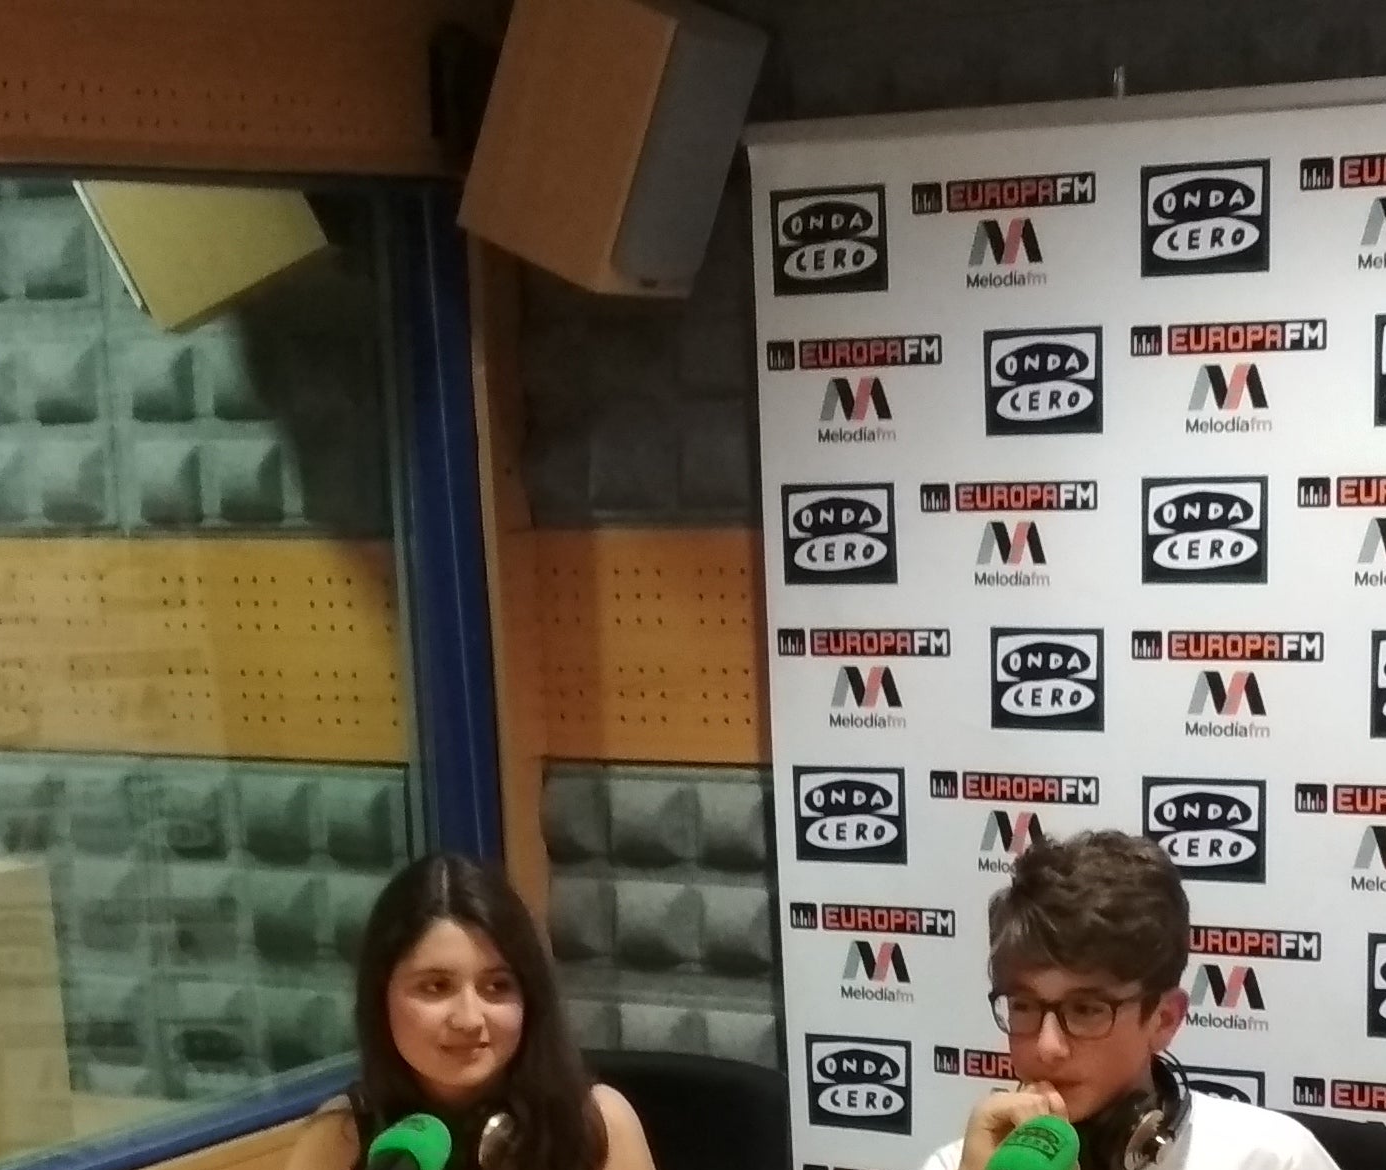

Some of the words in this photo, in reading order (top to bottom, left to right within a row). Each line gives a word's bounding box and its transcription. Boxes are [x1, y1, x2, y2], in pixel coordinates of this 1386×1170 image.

[950, 175, 1093, 209] EUROPAFM
[1163, 188, 1245, 213] ONDA
[790, 211, 864, 235] ONDA
[1167, 227, 1245, 251] CERO
[796, 248, 865, 271] CERO
[966, 269, 1046, 289] Melodíafm
[1172, 322, 1323, 351] EUROPAFM
[803, 338, 939, 366] EUROPAFM
[1004, 353, 1079, 375] ONDA
[1009, 390, 1080, 411] CERO
[1185, 416, 1271, 433] Melodíafm
[817, 426, 896, 444] Melodíafm
[958, 484, 1094, 508] EUROPAFM
[801, 508, 873, 527] ONDA
[1163, 502, 1243, 524] ONDA
[807, 542, 874, 562] CERO
[1167, 539, 1243, 560] CERO
[974, 571, 1049, 586] Melodíafm
[813, 632, 947, 653] EUROPAFM
[1172, 634, 1320, 658] EUROPAFM
[1010, 652, 1082, 671] ONDA
[1014, 687, 1082, 706] CERO
[829, 713, 901, 728] Melodíafm
[1185, 721, 1270, 737] Melodíafm
[812, 789, 884, 807] ONDA
[965, 775, 1096, 802] EUROPAFM
[1163, 802, 1242, 821] ONDA
[818, 822, 885, 840] CERO
[1168, 838, 1242, 857] CERO
[825, 906, 952, 934] EUROPAFM
[1190, 929, 1317, 959] UROPAFM
[840, 985, 912, 1003] Melodíafm
[824, 1057, 890, 1076] ONDA
[829, 1090, 891, 1110] CERO
